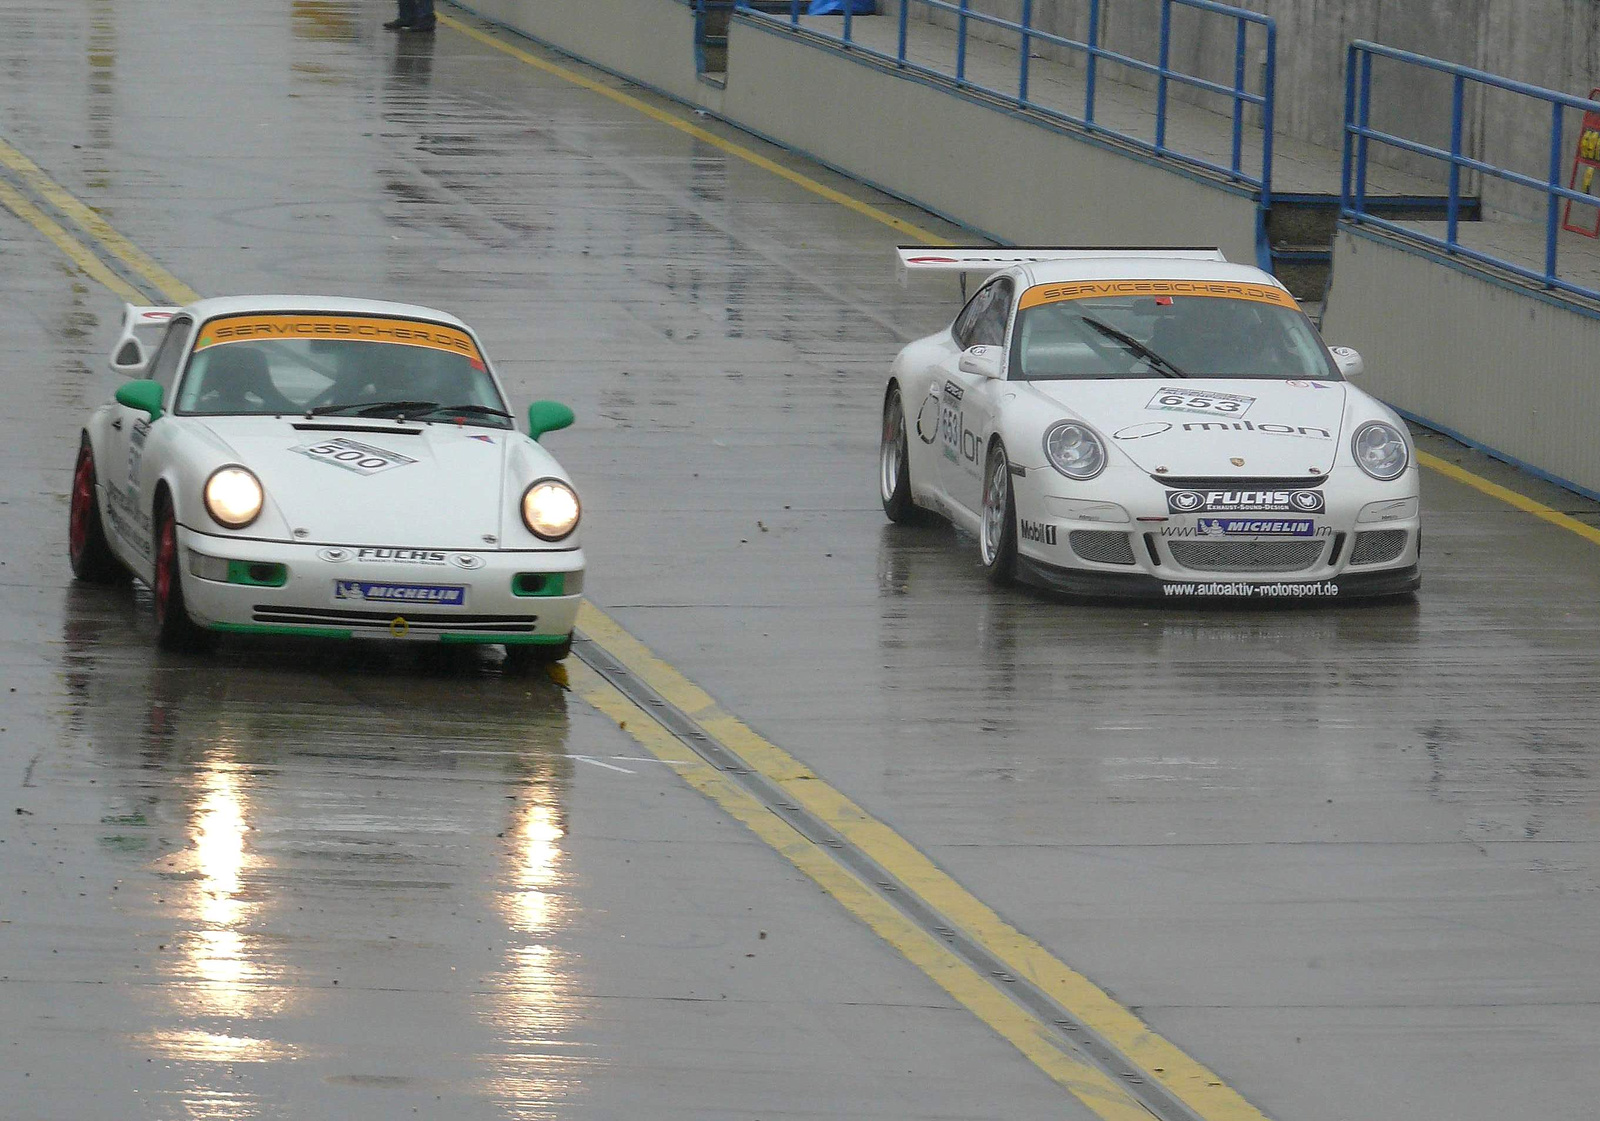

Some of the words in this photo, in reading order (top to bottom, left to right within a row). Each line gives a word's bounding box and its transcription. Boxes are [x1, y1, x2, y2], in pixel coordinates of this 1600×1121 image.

[1043, 283, 1282, 301] SERVICESICHER.DE
[215, 323, 471, 350] SERVICESICHER.DE
[1159, 395, 1241, 412] 653
[943, 408, 958, 446] 653
[1183, 421, 1331, 438] milon
[309, 445, 388, 468] 500
[1206, 491, 1290, 505] FUCHS
[1021, 519, 1045, 543] Mobil
[1227, 521, 1310, 532] MICHELIN
[358, 548, 447, 561] FUCHS
[367, 586, 460, 600] MICHELIN
[1163, 581, 1338, 597] www.autoaktiv-motorsport.de
